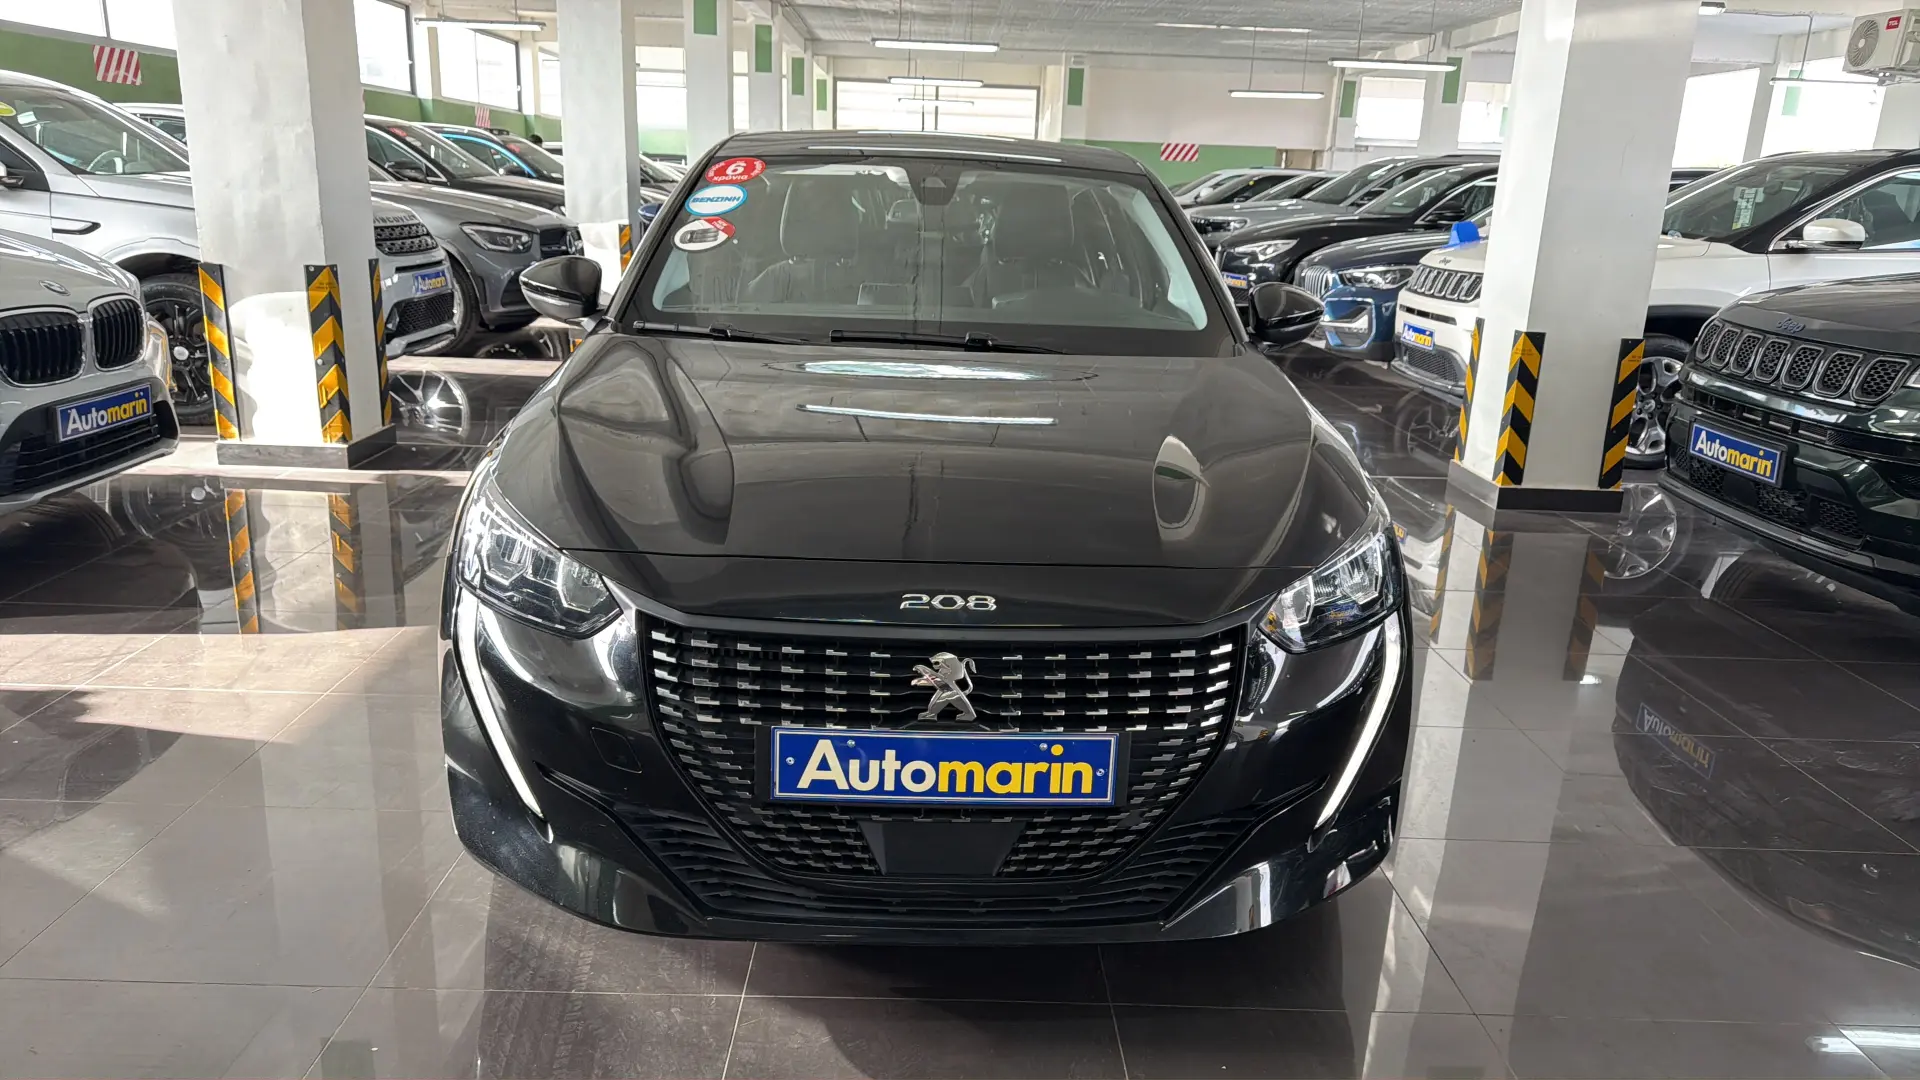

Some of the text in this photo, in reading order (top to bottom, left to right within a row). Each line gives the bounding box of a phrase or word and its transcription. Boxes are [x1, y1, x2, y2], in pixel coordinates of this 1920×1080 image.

[725, 162, 747, 176] 6
[1777, 318, 1805, 334] Jeep
[66, 391, 147, 435] Automarin
[1694, 430, 1773, 477] Automarin
[900, 594, 997, 611] 208
[796, 739, 1093, 794] Automarin
